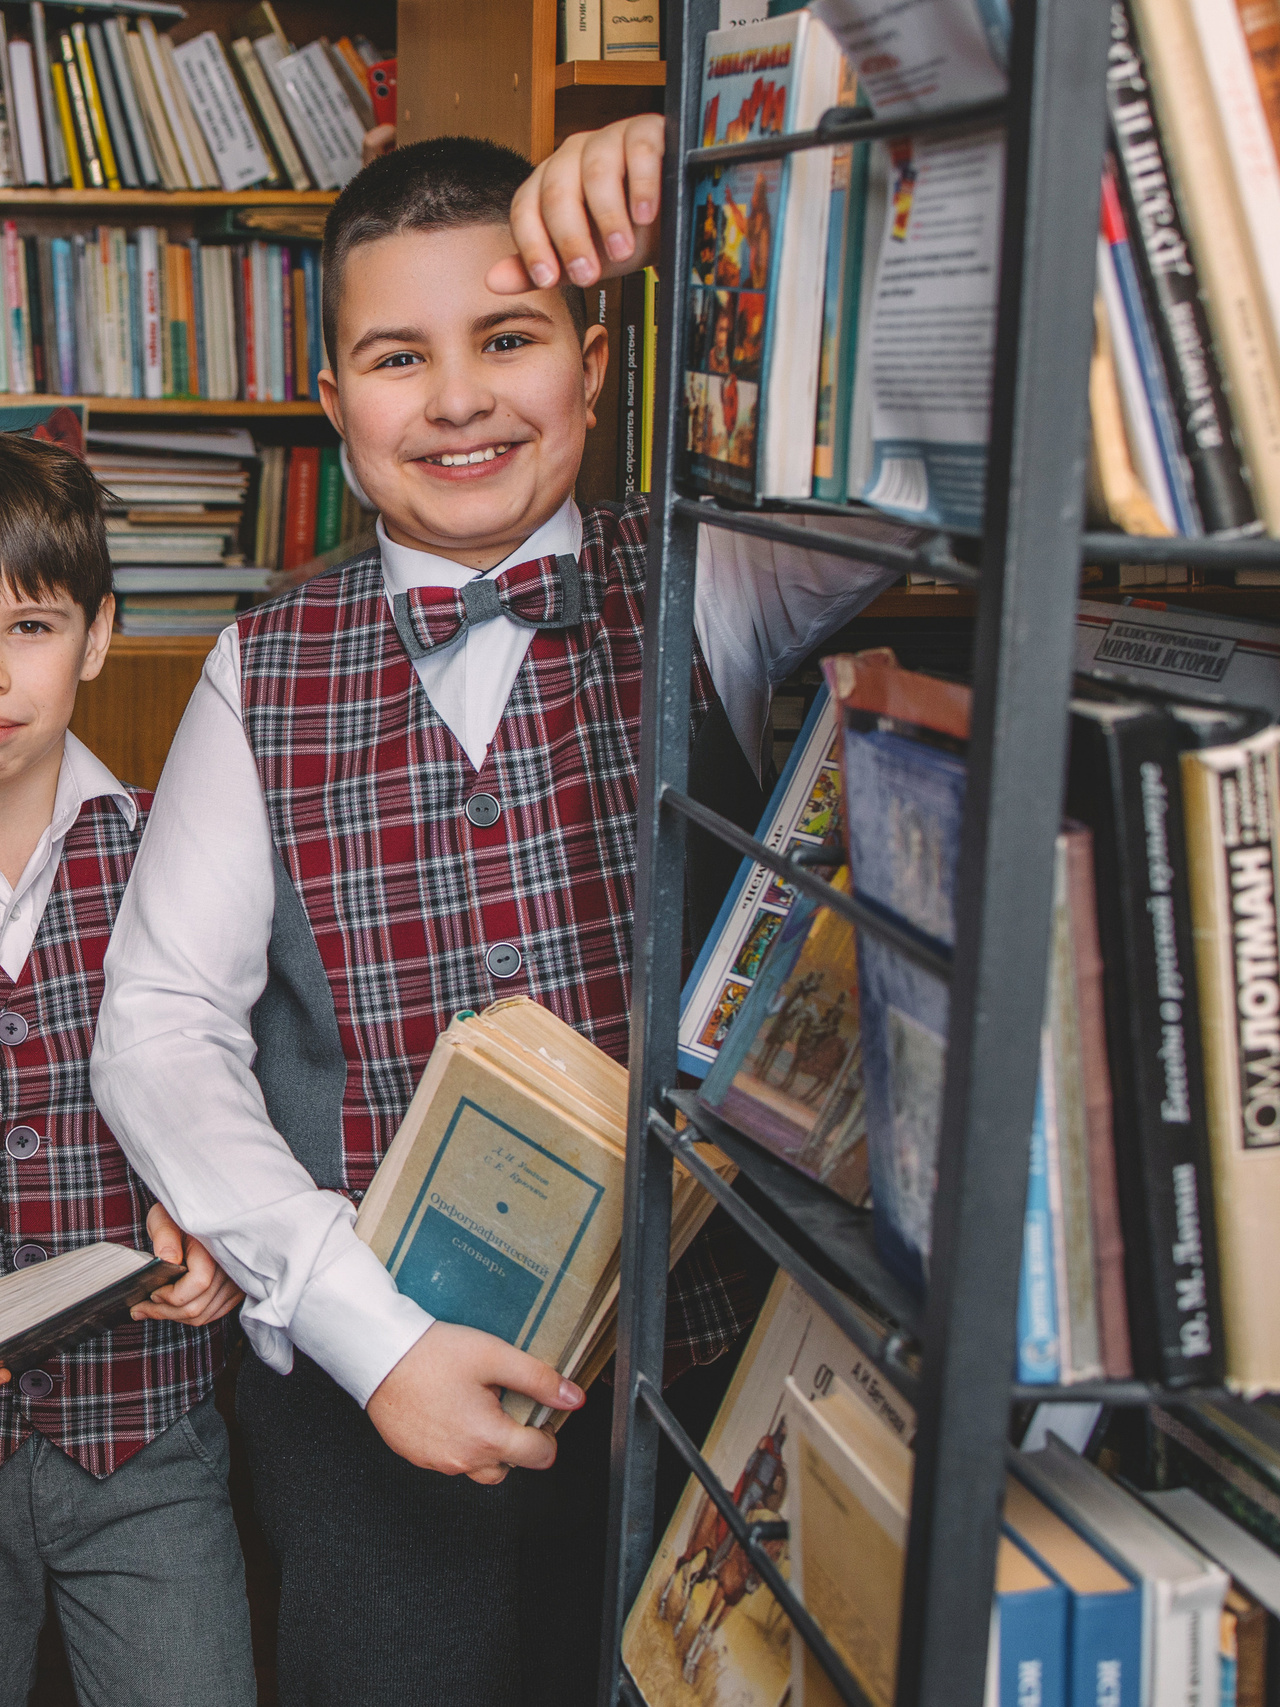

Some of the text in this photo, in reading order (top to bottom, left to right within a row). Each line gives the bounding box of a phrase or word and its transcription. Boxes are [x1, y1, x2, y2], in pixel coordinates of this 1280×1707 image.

[598, 290, 606, 323] ГРИБЫ
[624, 324, 637, 499] ас- определитель высших растений
[1100, 638, 1227, 676] МИРОВАЯ ИСТОРИЯ
[1146, 895, 1185, 1000] русской
[1229, 847, 1280, 1056] ЛОТМАН
[1159, 1001, 1183, 1023] о
[1156, 1024, 1191, 1124] Беседы
[429, 1191, 552, 1278] Орфографический
[450, 1235, 509, 1278] словарь
